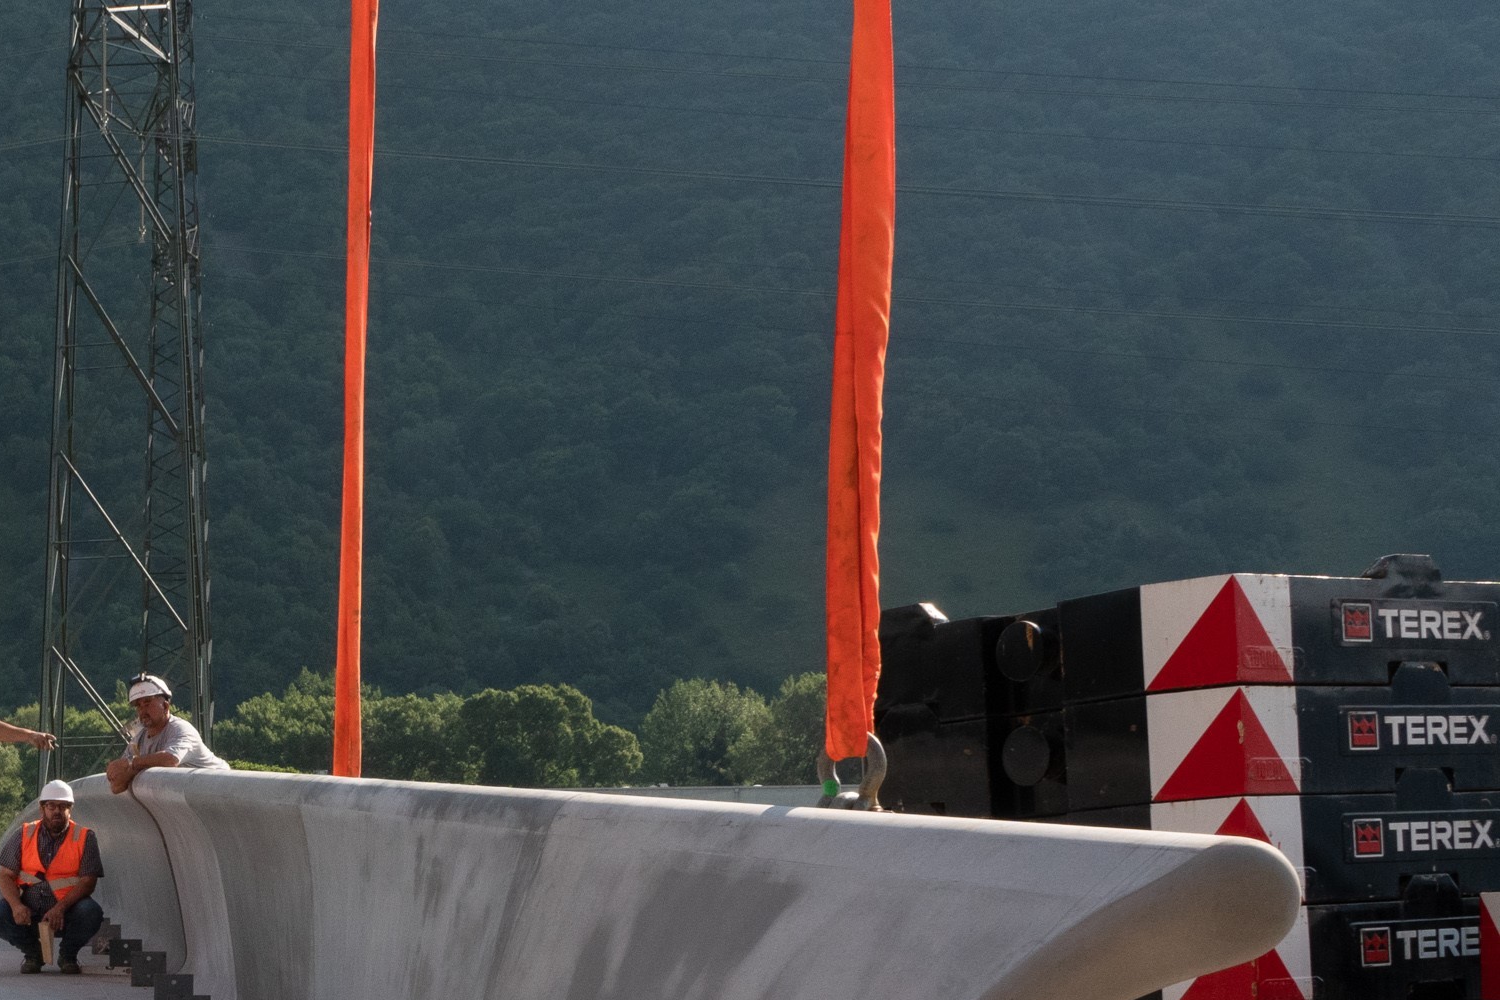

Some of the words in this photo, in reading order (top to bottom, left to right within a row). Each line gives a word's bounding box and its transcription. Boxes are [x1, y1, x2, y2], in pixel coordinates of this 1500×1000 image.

[1378, 608, 1484, 640] TEREX
[1384, 715, 1491, 745] TEREX
[1388, 819, 1495, 852] TEREX
[1396, 926, 1480, 960] TERE
